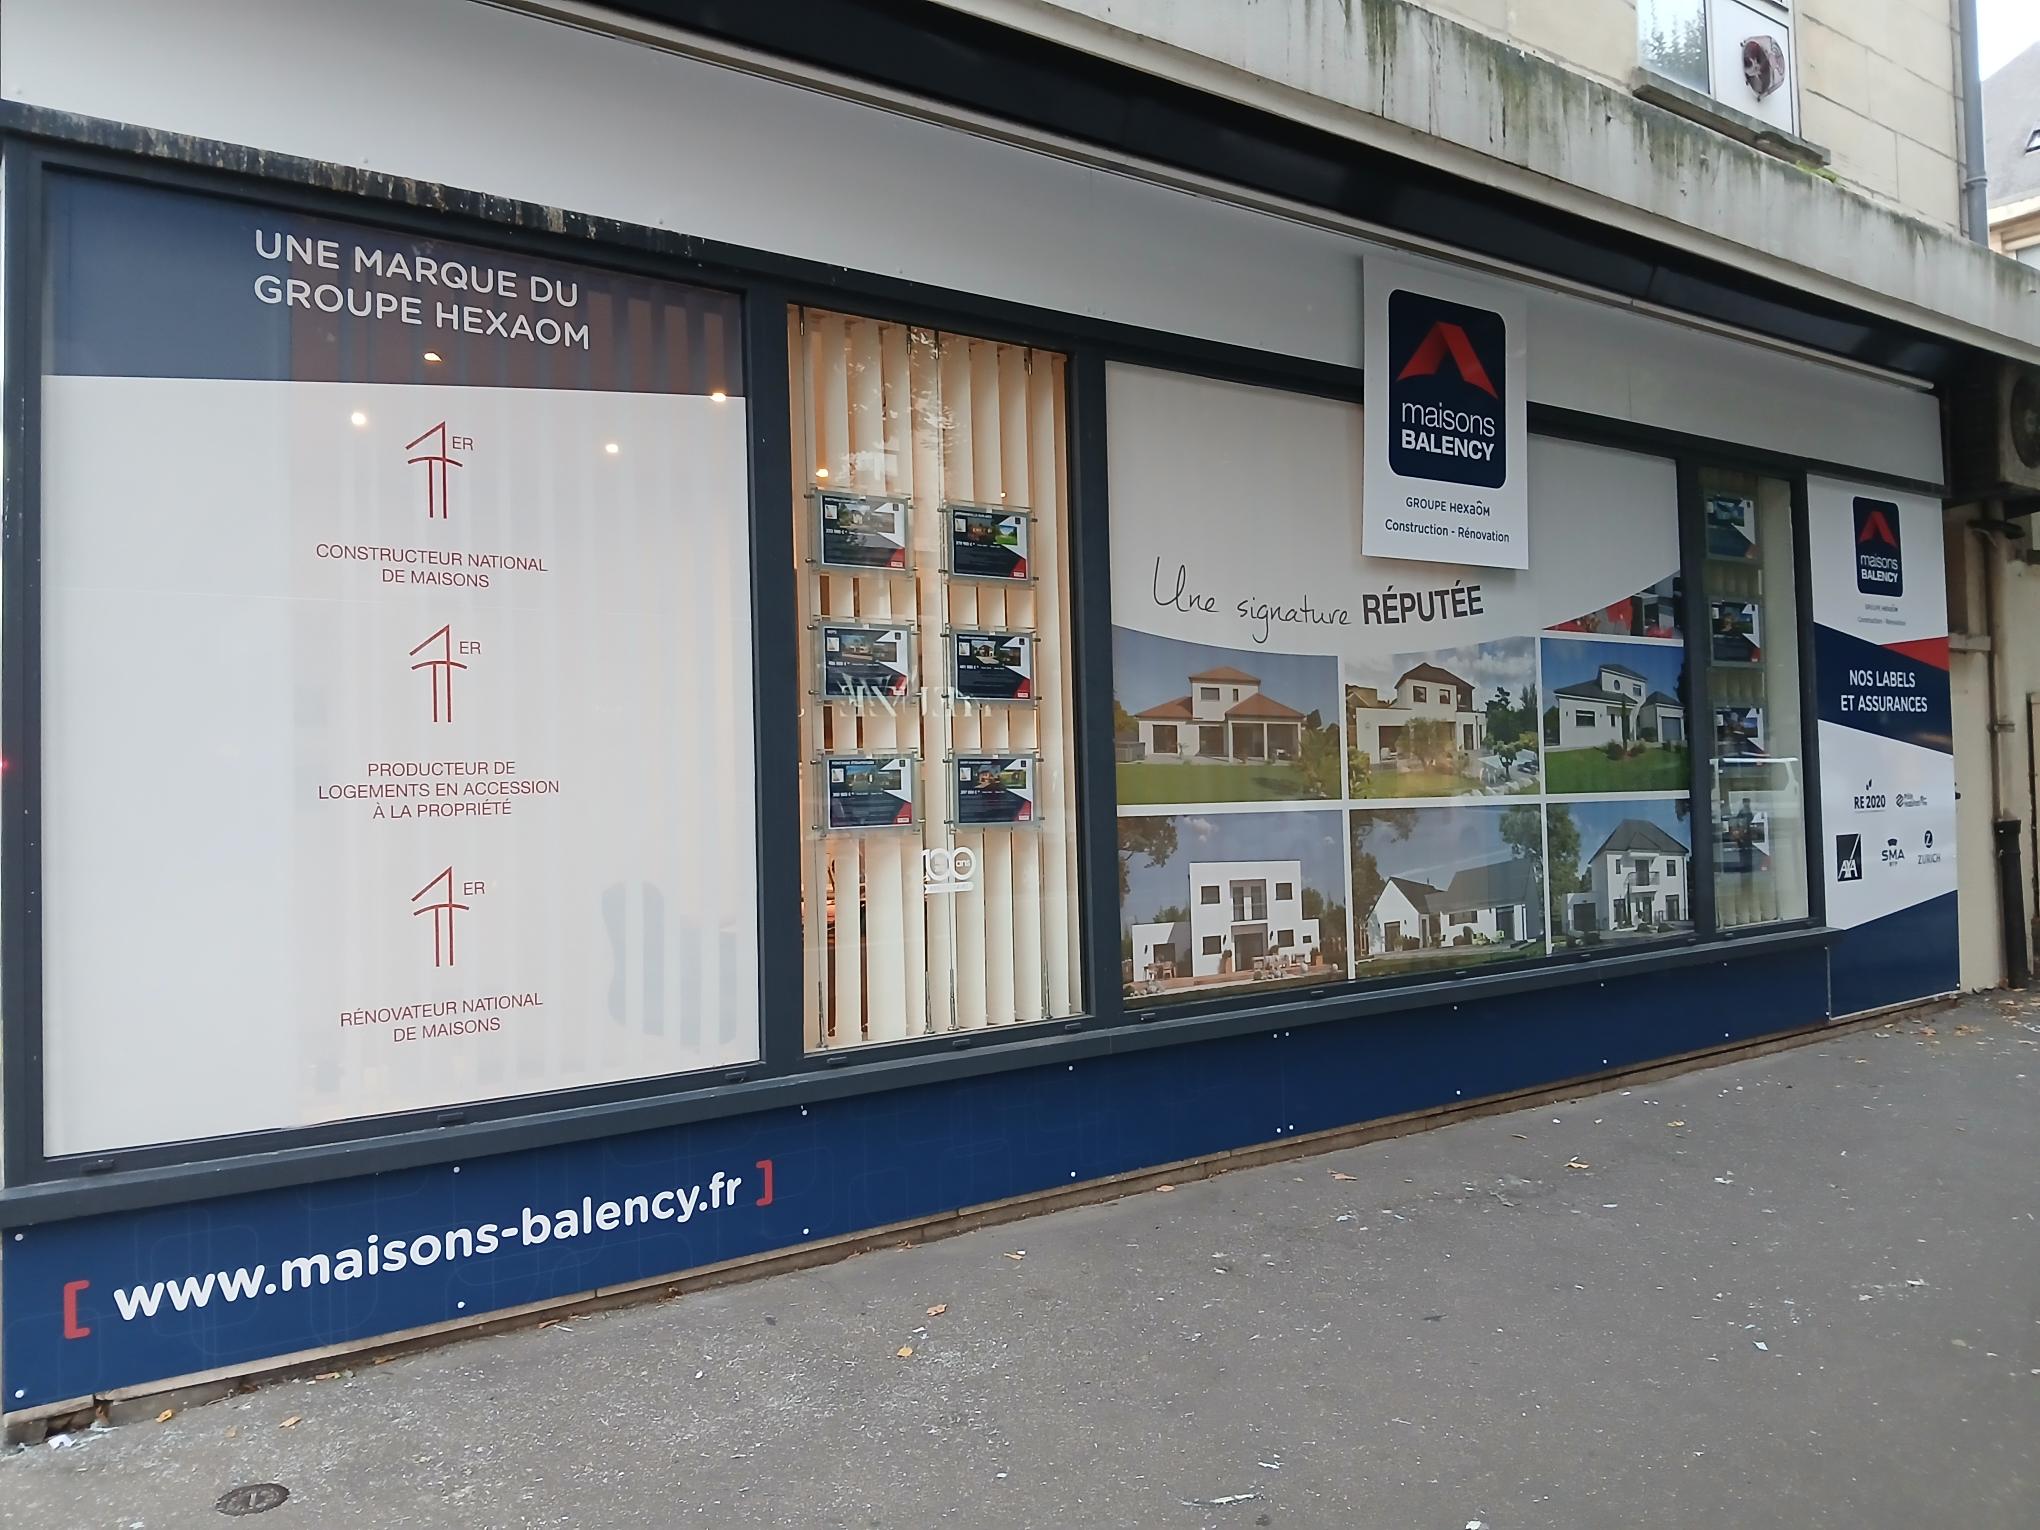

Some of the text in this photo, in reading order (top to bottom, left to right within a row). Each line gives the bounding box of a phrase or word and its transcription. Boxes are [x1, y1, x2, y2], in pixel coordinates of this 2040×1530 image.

[255, 229, 578, 308] UNE MARQUE DU
[254, 275, 590, 350] GROUPE HEXAOM
[1401, 402, 1496, 437] maisons
[1401, 429, 1495, 461] BALENCY
[1405, 497, 1447, 512] GROUPE
[1385, 519, 1449, 537] Construction
[1458, 527, 1510, 543] Rénovation
[316, 543, 549, 572] CONSTRUCTEUR NATIONAL
[1860, 554, 1899, 570] maisons
[382, 569, 489, 588] DE MAISONS
[1861, 569, 1898, 583] BALENCY
[1153, 556, 1484, 644] Une signature RÉPUTÉE
[1849, 669, 1916, 688] NOS LABELS
[1840, 695, 1928, 713] ET ASSURANCES
[368, 761, 516, 777] PRODUCTEUR DE
[318, 780, 560, 800] LOGEMENTS EN ACCESSION
[372, 799, 512, 820] À LA PROPRIÉTÉ
[1854, 794, 1886, 809] RE 2020
[1881, 848, 1905, 861] SMA
[1917, 852, 1941, 865] ZURICH
[340, 993, 543, 1027] RÉNOVATEUR NATIONAL
[393, 1017, 501, 1042] DE MAISONS
[113, 1171, 743, 1322] www.maisons-balency.fr
